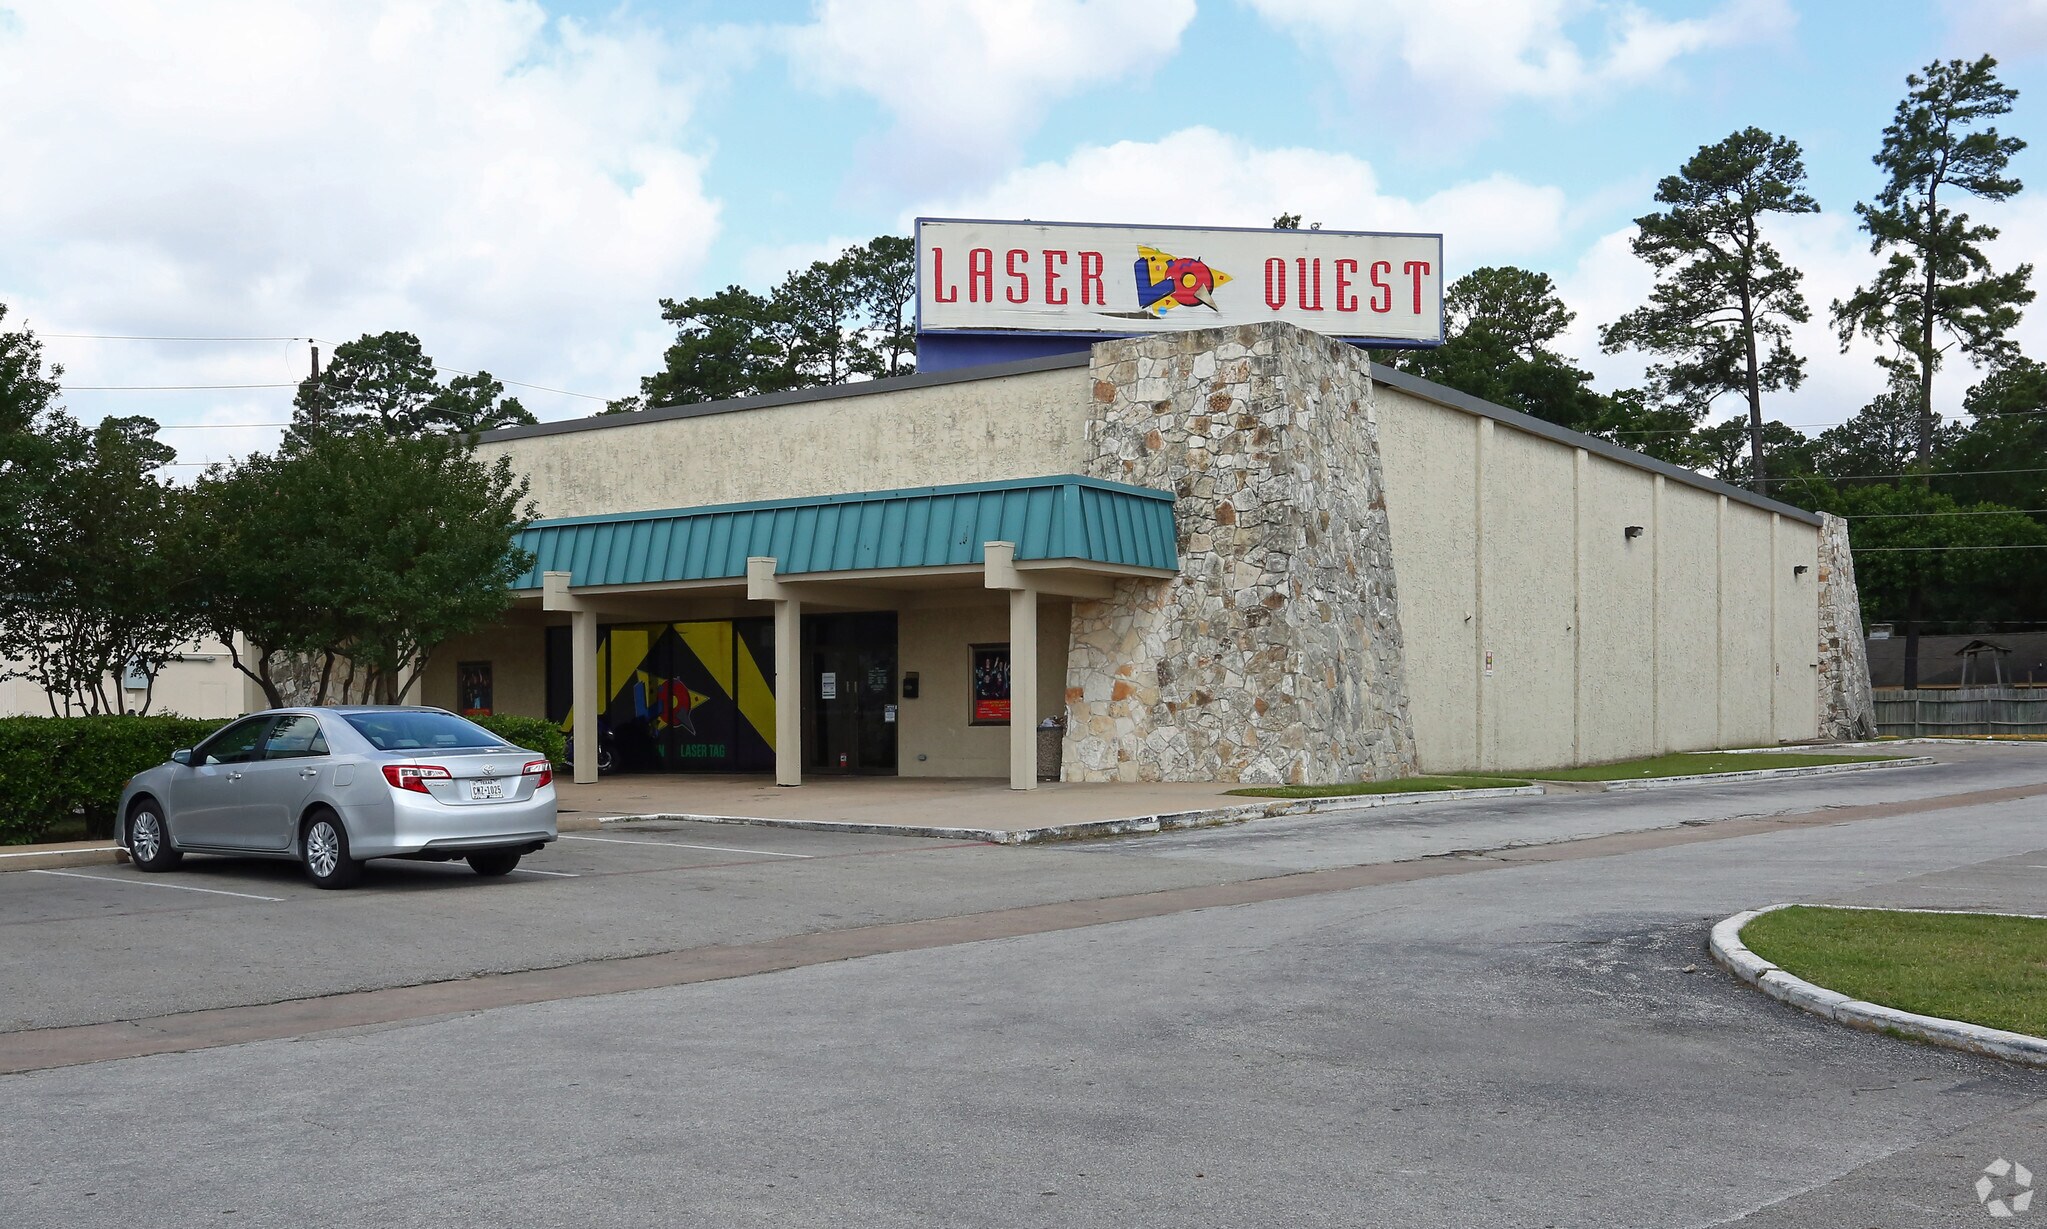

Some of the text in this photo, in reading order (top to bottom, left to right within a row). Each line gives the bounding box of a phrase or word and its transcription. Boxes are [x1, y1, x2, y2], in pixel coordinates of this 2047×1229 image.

[931, 247, 1106, 306] LASER
[1264, 256, 1431, 315] QUEST
[680, 744, 707, 758] LASER
[708, 744, 726, 758] TAG
